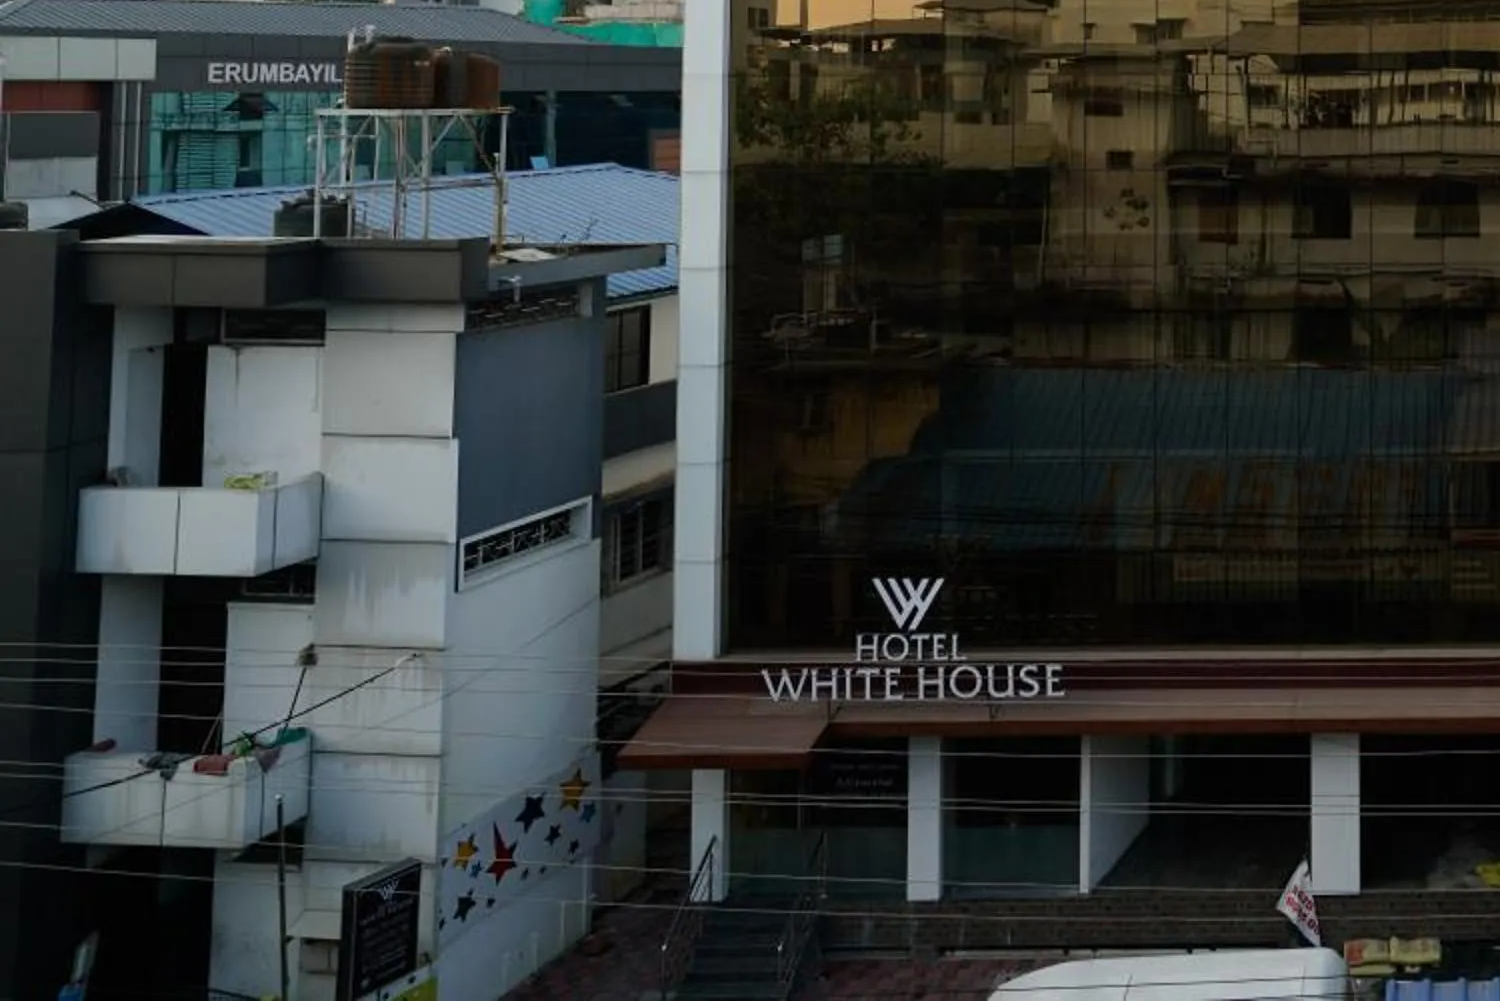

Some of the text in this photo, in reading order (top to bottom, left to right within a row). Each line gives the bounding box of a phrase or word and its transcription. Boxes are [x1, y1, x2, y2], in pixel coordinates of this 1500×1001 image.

[207, 62, 343, 84] ERUMBAYIL
[856, 633, 966, 662] HOTEL
[761, 664, 1066, 703] WHITE HOUSE
